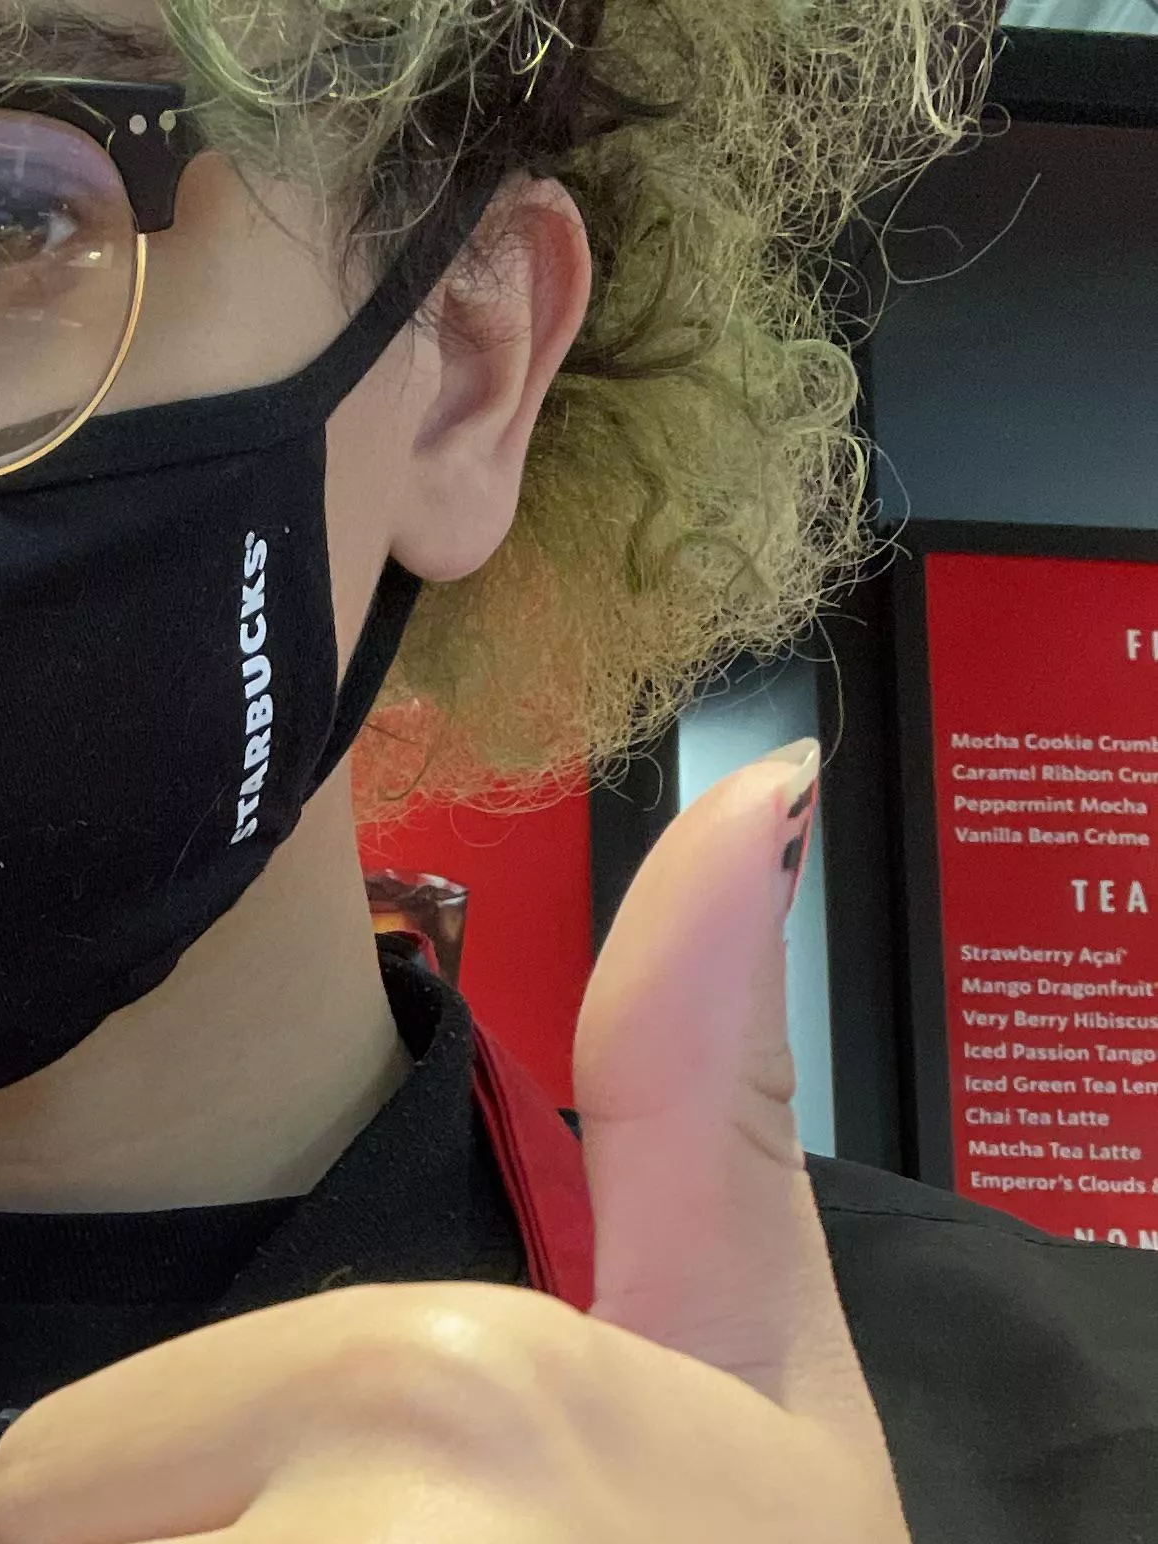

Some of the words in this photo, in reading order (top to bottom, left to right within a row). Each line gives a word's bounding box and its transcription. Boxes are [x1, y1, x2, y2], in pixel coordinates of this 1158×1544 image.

[230, 531, 274, 845] STARBUCKS
[951, 733, 1019, 750] Mocha
[1024, 734, 1093, 751] Cookie
[952, 764, 1036, 781] Caramel
[1042, 765, 1113, 783] Ribbon
[953, 796, 1074, 815] Peppermint
[1080, 798, 1147, 815] Mocha
[955, 826, 1022, 844] Vanilla
[1029, 828, 1079, 845] Bean
[1084, 829, 1150, 846] Crème
[1071, 879, 1149, 913] TEA
[960, 945, 1073, 966] Strawberry
[961, 978, 1031, 998] Mango
[962, 1010, 1008, 1030] Very
[1014, 1010, 1068, 1031] Berry
[1074, 1012, 1158, 1029] Hibiscus
[963, 1043, 1006, 1060] Iced
[1012, 1043, 1089, 1061] Passion
[1094, 1044, 1155, 1065] Tango
[965, 1075, 1007, 1092] Iced
[1013, 1076, 1076, 1093] Green
[1082, 1077, 1116, 1094] Tea
[965, 1108, 1010, 1126] Chai
[1017, 1109, 1051, 1126] Tea
[1057, 1109, 1110, 1126] Latte
[968, 1140, 1043, 1159] Matcha
[1049, 1142, 1083, 1160] Tea
[1089, 1143, 1142, 1160] Latte
[970, 1172, 1072, 1193] Emperor's
[1078, 1175, 1146, 1194] Clouds
